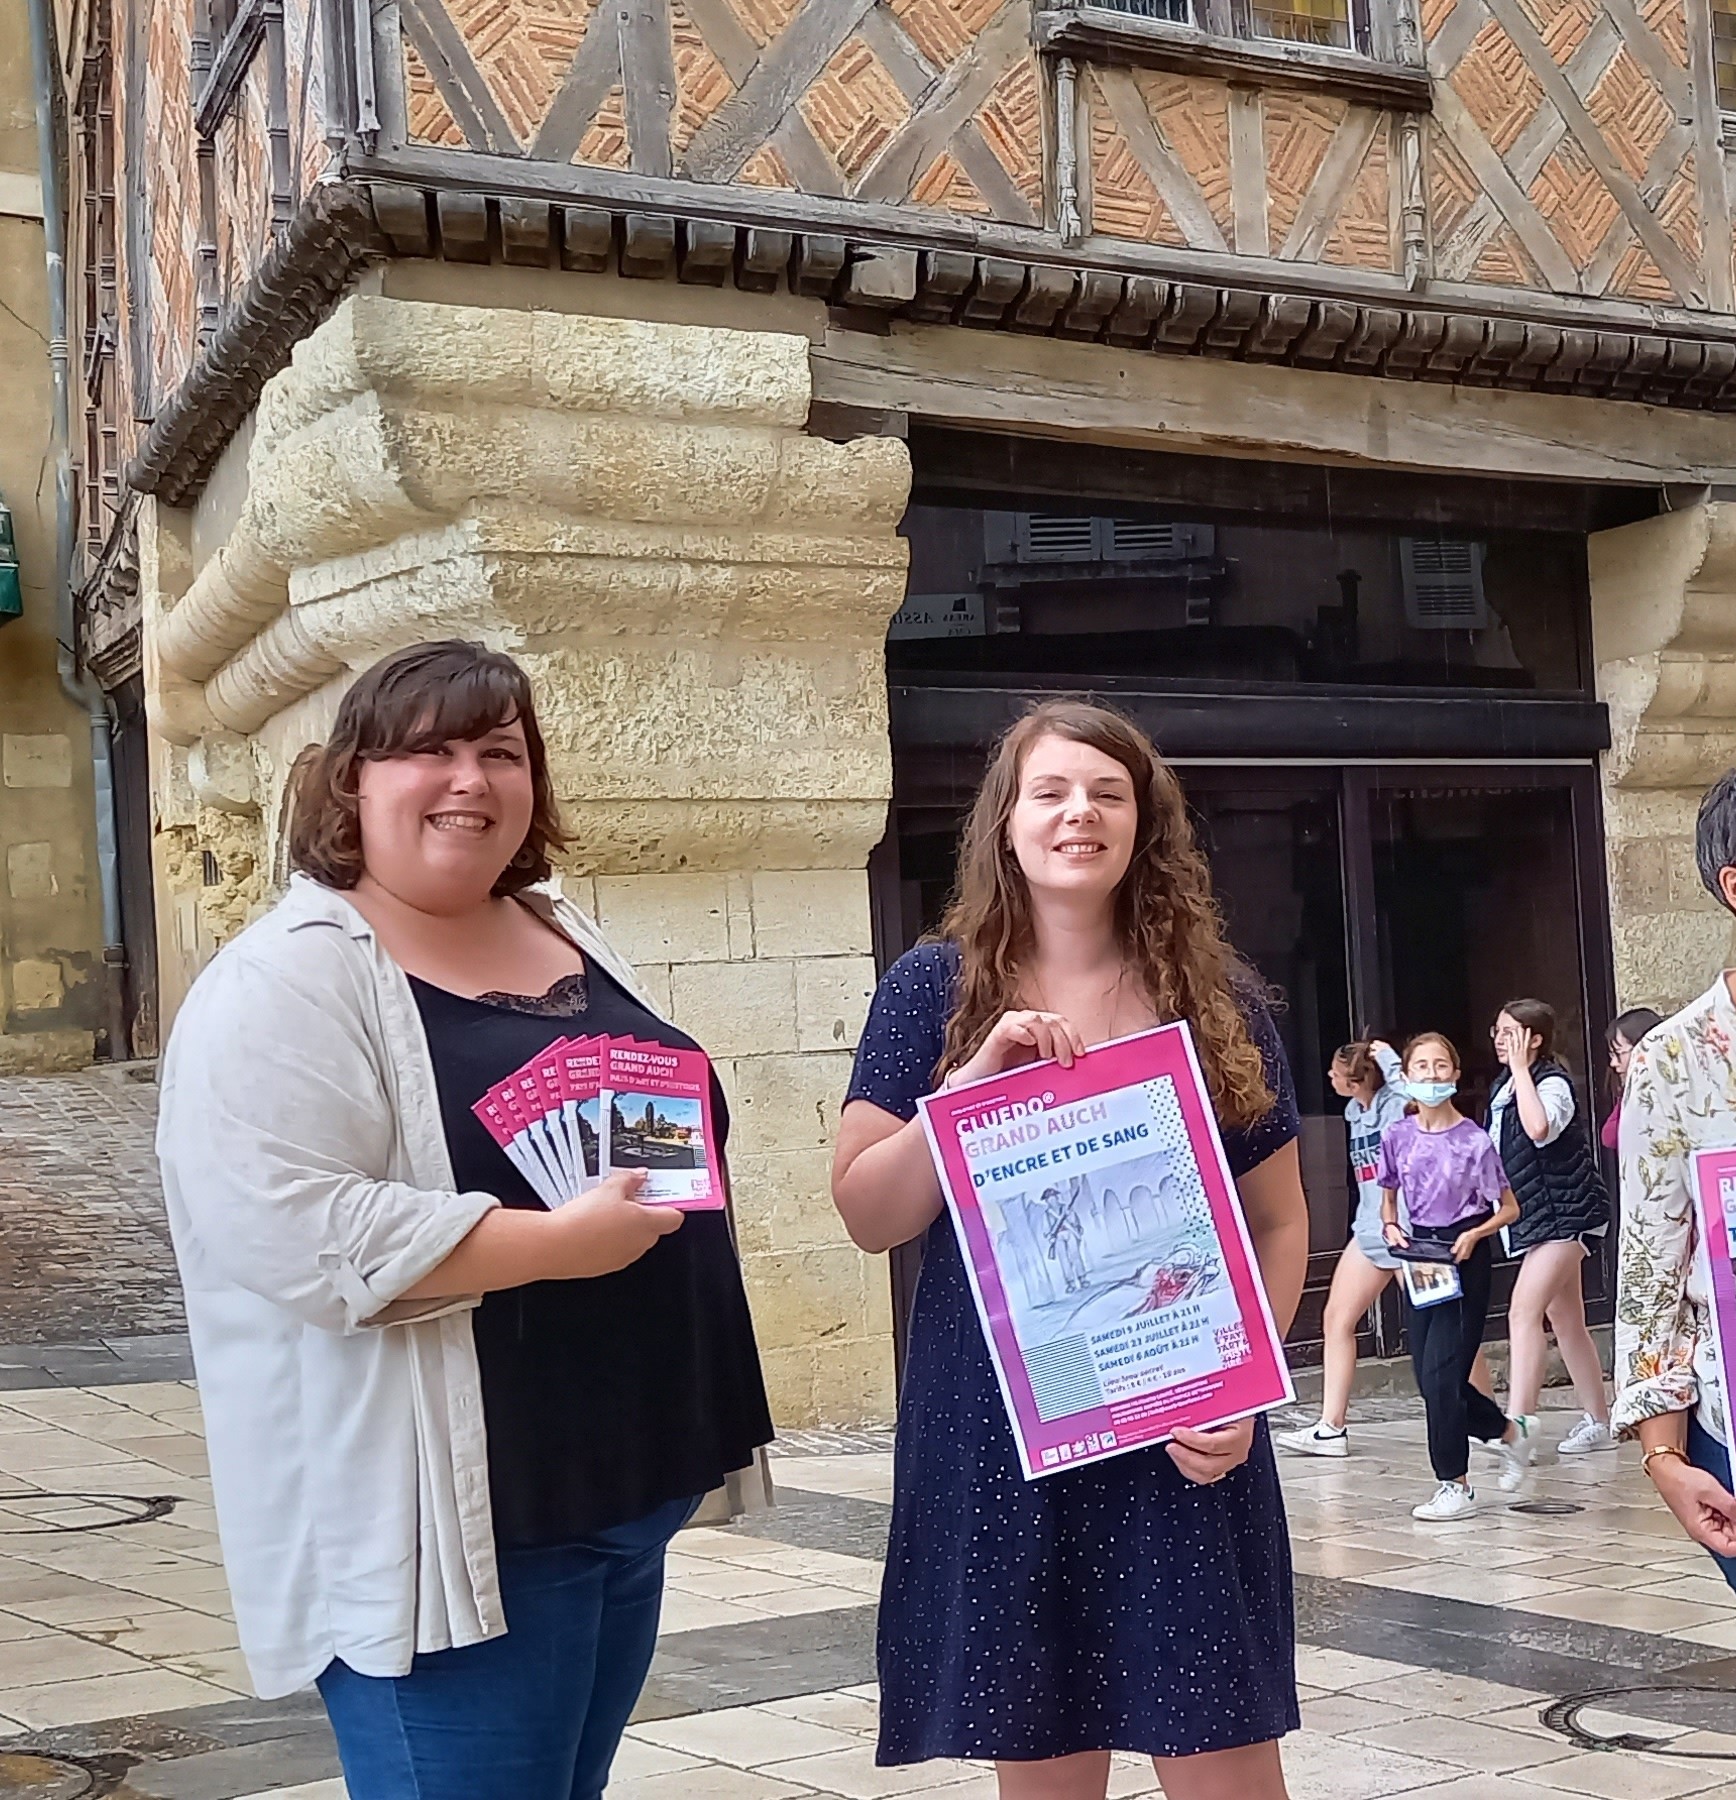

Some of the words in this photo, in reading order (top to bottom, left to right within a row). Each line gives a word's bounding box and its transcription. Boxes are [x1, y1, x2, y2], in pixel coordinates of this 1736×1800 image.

[610, 1049, 678, 1067] RENDEZ-VOUS
[610, 1061, 645, 1074] GRAND
[965, 1124, 1040, 1158] GRAND
[1048, 1101, 1107, 1134] AUCH
[973, 1153, 1049, 1188] D'ENCRE
[1051, 1145, 1072, 1163] ET
[1076, 1137, 1099, 1156] DE
[1102, 1123, 1148, 1148] SANG
[1091, 1328, 1126, 1345] SAMEDI
[1135, 1314, 1170, 1331] JUILLET
[1094, 1340, 1130, 1358] SAMEDI
[1145, 1326, 1179, 1344] JUILLET
[1098, 1355, 1135, 1372] SAMEDI
